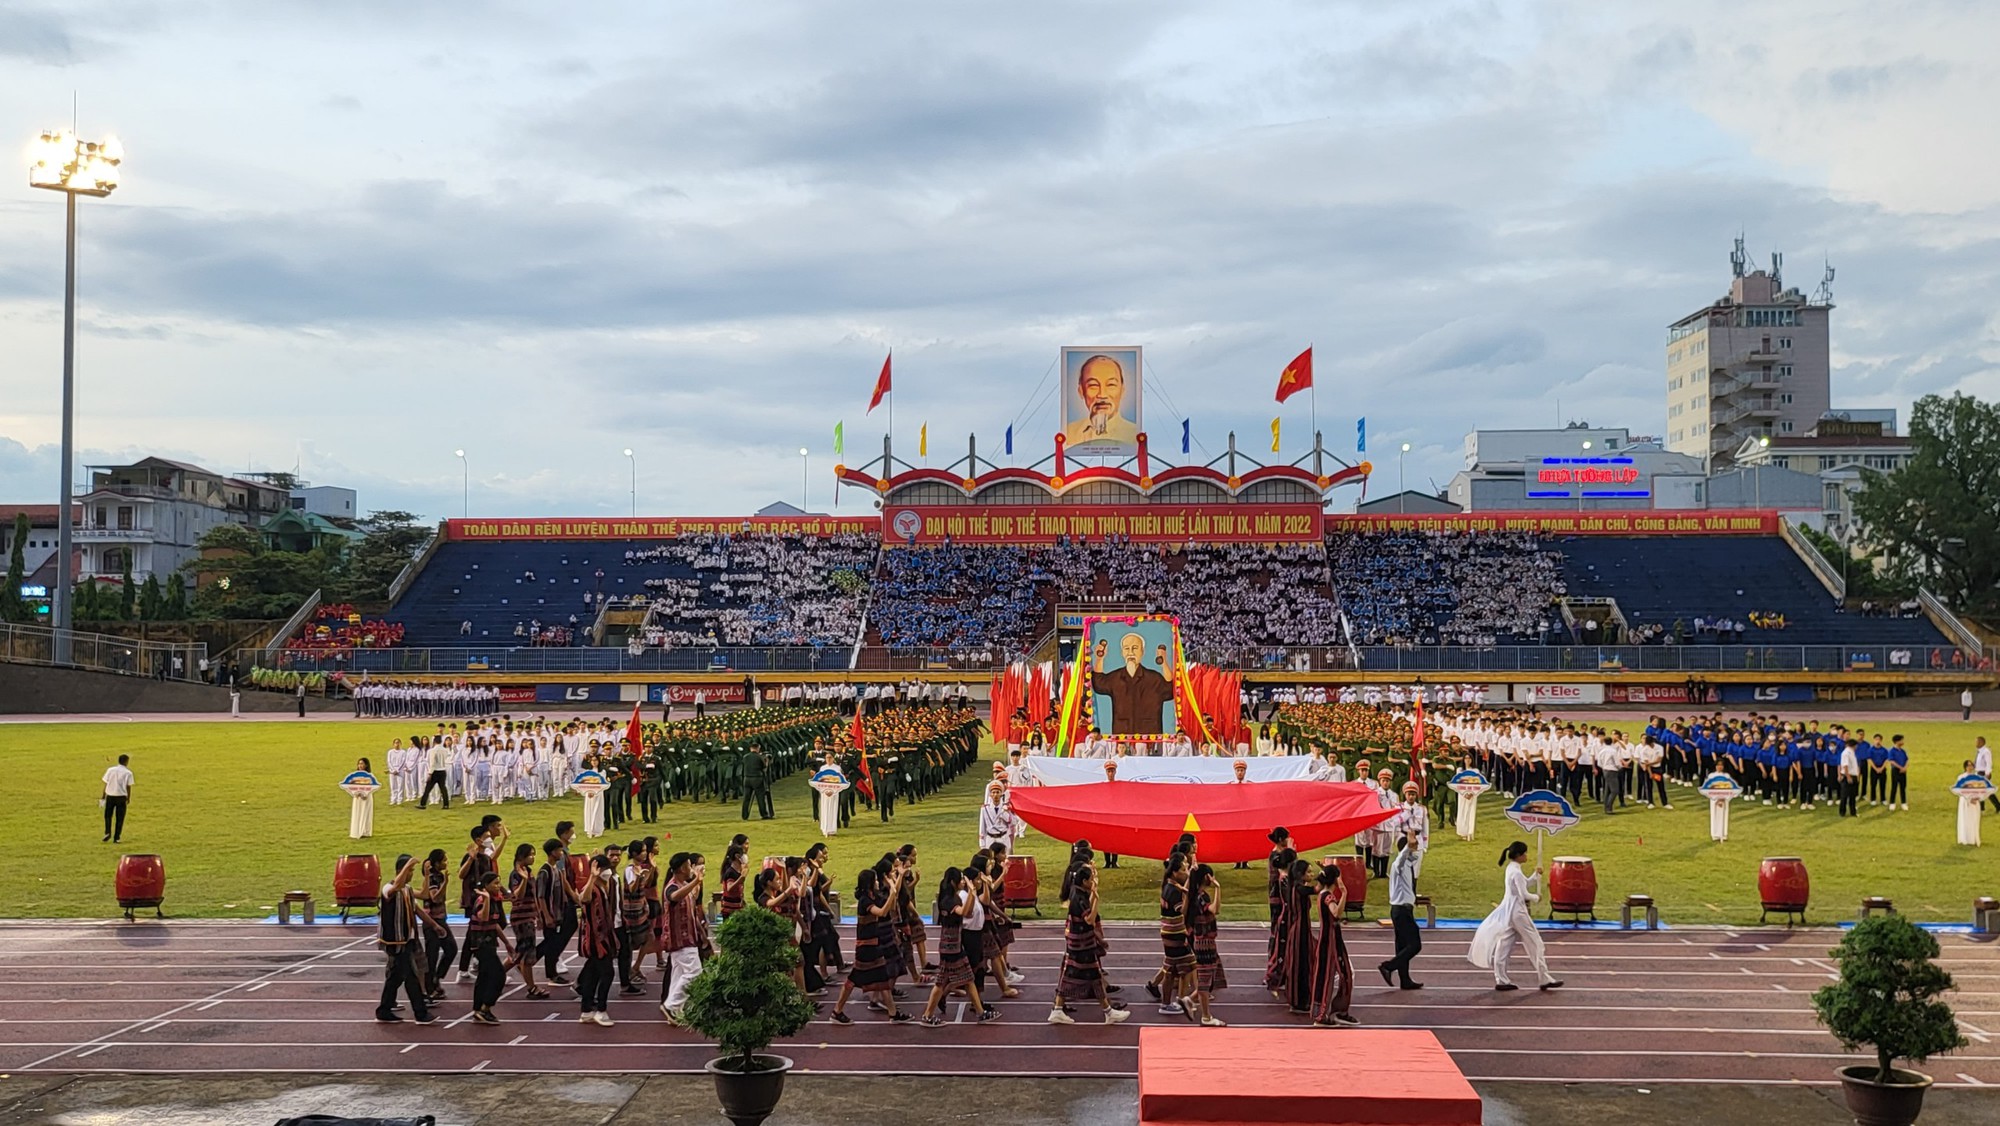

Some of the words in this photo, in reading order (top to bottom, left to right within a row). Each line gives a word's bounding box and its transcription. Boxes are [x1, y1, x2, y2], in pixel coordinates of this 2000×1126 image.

[463, 521, 498, 536] TOÀN
[502, 521, 531, 536] DÂN
[534, 520, 562, 536] RÈN
[565, 521, 609, 538] LUYỆN
[612, 520, 648, 535] THÂN
[652, 518, 677, 535] THỂ
[681, 523, 715, 534] THEO
[770, 519, 798, 534] BÁC
[926, 517, 944, 539] ĐẠI
[947, 513, 966, 539] HỘI
[968, 509, 989, 535] THỂ
[992, 516, 1013, 539] DỤC
[1016, 509, 1037, 535] THỂ
[1039, 516, 1066, 535] THAO
[1069, 511, 1094, 535] TỈNH
[1098, 511, 1126, 535] THỪA
[1129, 512, 1160, 535] THIÊN
[1164, 508, 1186, 535] HUẾ
[1188, 508, 1210, 535] LẦN
[1212, 511, 1235, 535] THỨ
[1237, 516, 1252, 537] IX,
[1255, 511, 1281, 535] NĂM
[1284, 515, 1312, 534] 2022
[1336, 516, 1355, 531] TẤT
[1358, 516, 1374, 532] CẢ
[1376, 516, 1387, 532] VÌ
[1418, 517, 1442, 532] TIÊU
[1444, 517, 1467, 531] DÂN
[1505, 516, 1537, 531] NƯỚC
[1540, 519, 1577, 533] MẠNH,
[1580, 517, 1602, 530] DÂN
[1606, 515, 1632, 531] CHỦ,
[1635, 517, 1665, 530] CÔNG
[1668, 513, 1702, 531] BẰNG,
[1705, 516, 1728, 530] VĂN
[1730, 517, 1761, 529] MINH
[565, 687, 590, 700] LS
[684, 686, 745, 697] www.vpf.v
[1535, 685, 1581, 697] K-Elec
[1753, 686, 1779, 700] LS
